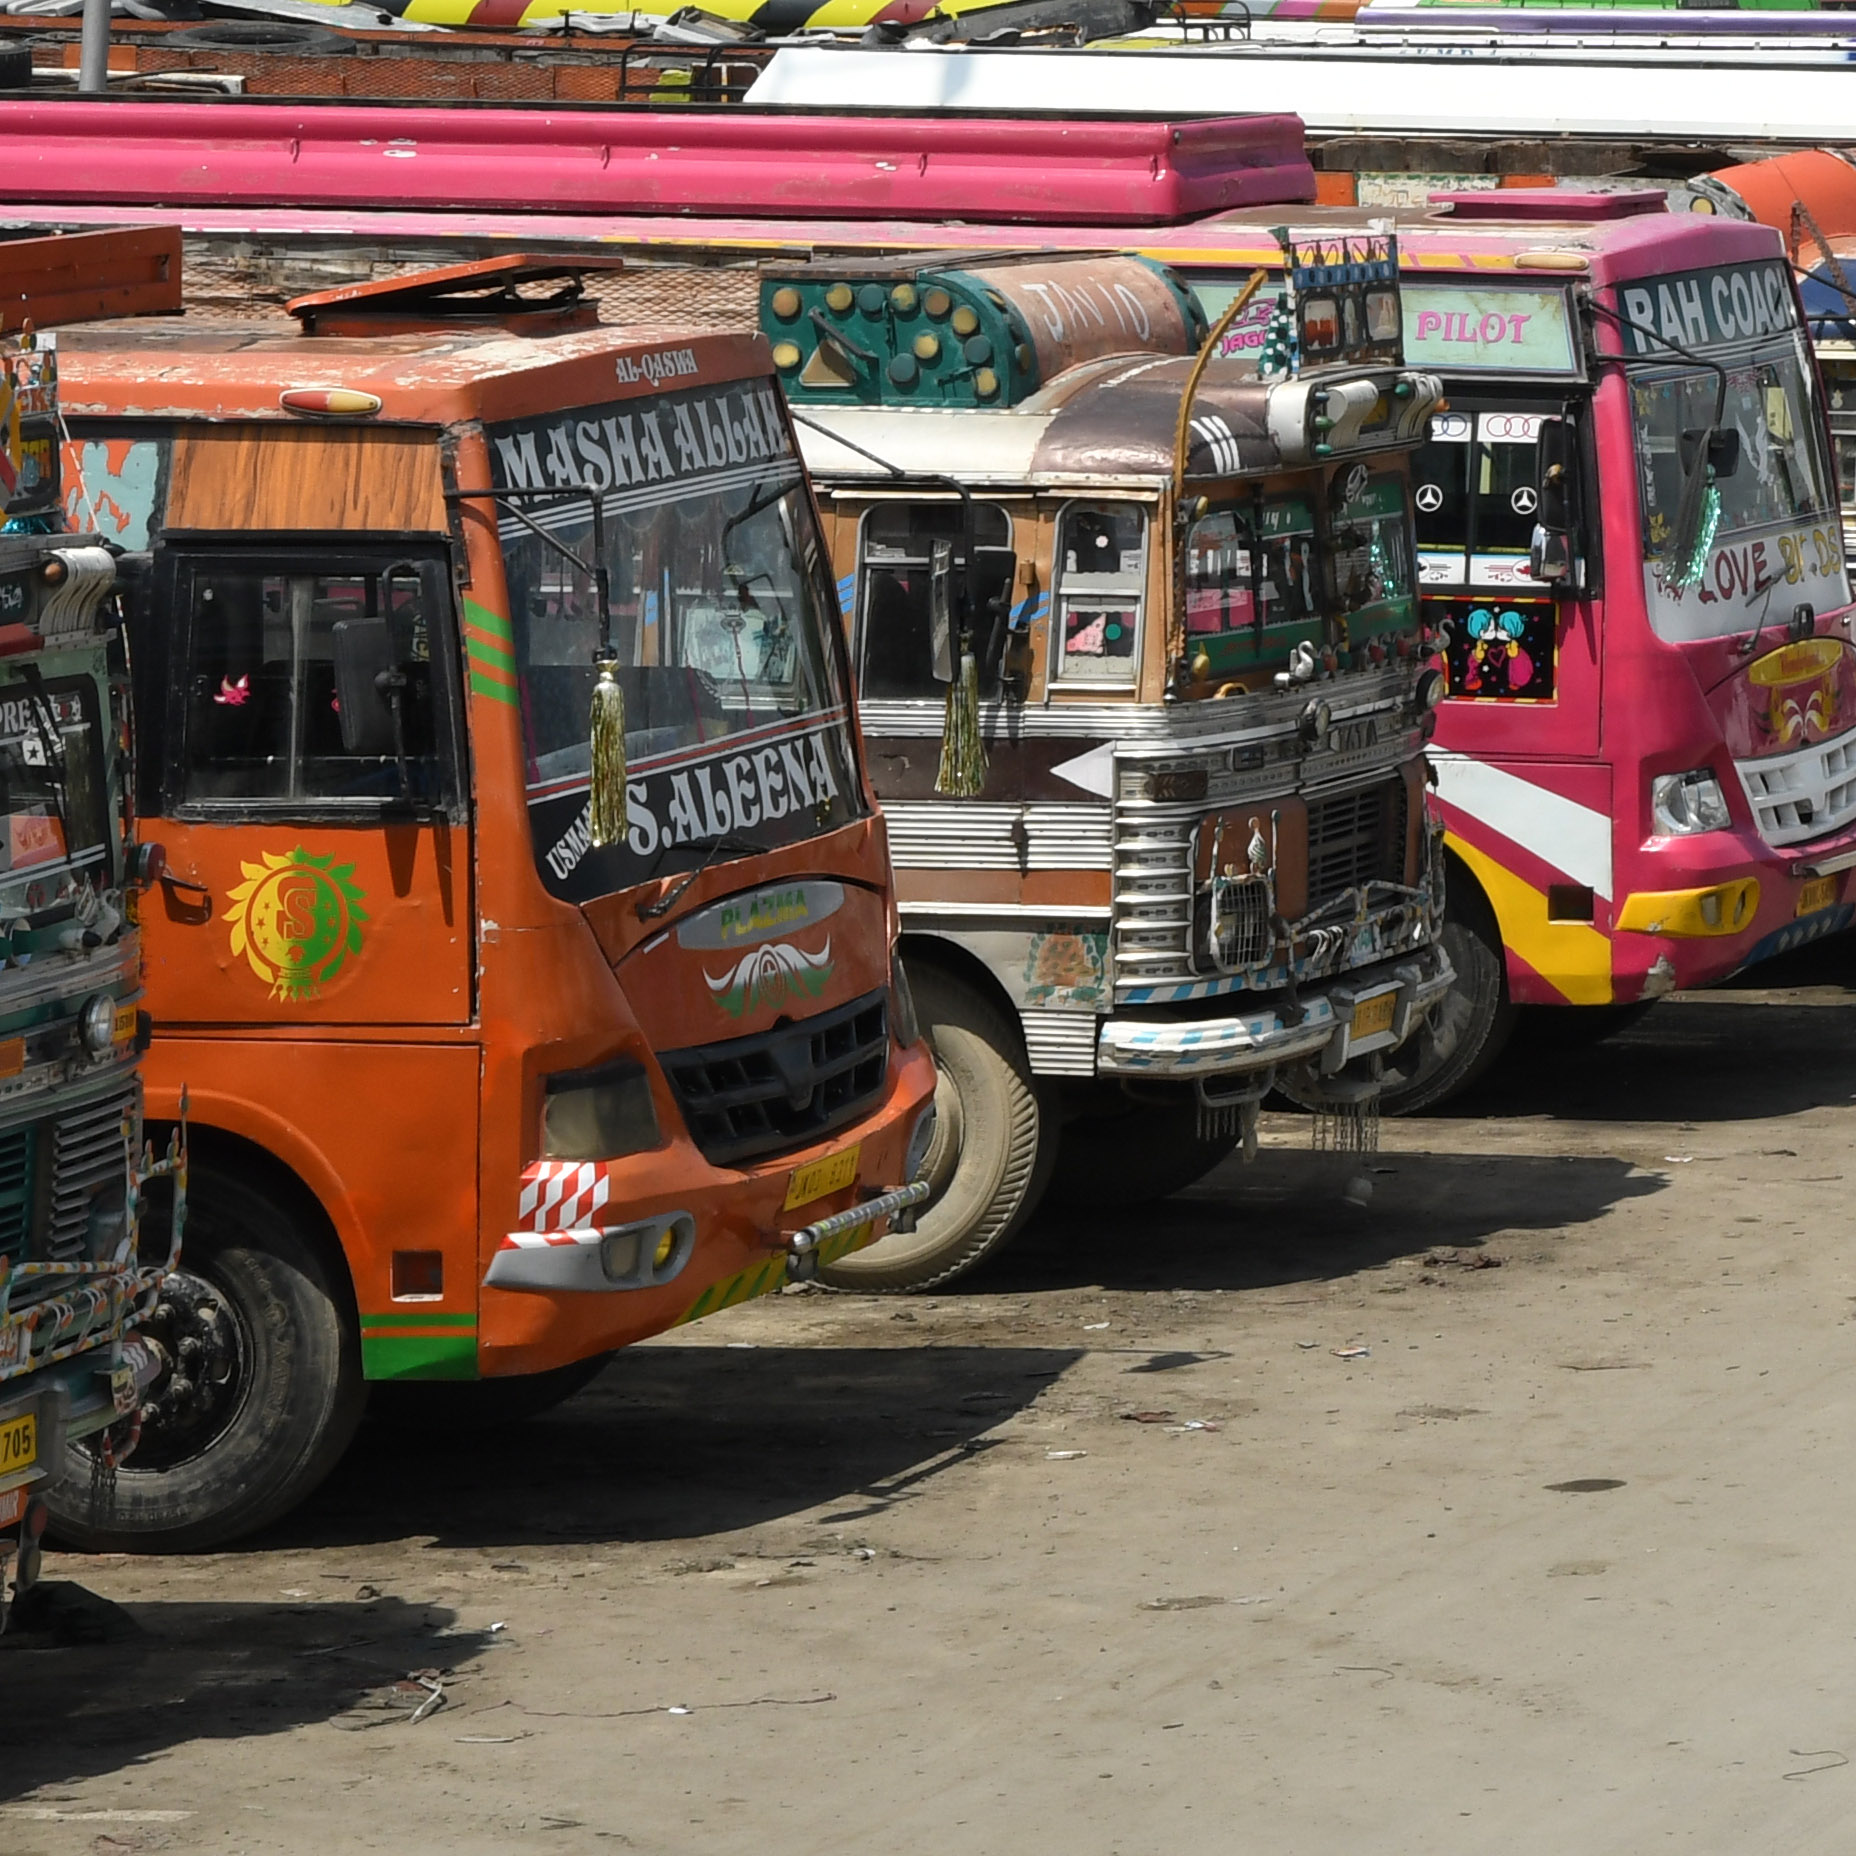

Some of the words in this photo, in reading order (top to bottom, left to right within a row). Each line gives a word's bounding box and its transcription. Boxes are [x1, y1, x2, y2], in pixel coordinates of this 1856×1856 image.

[1416, 310, 1532, 344] PILOT
[1625, 273, 1709, 355] RAH
[616, 348, 699, 387] AL-QASWA
[494, 408, 676, 507] MASHA
[673, 388, 793, 472] ALLAH
[626, 731, 839, 856] S.ALEENA
[720, 888, 808, 940] PLAZMA
